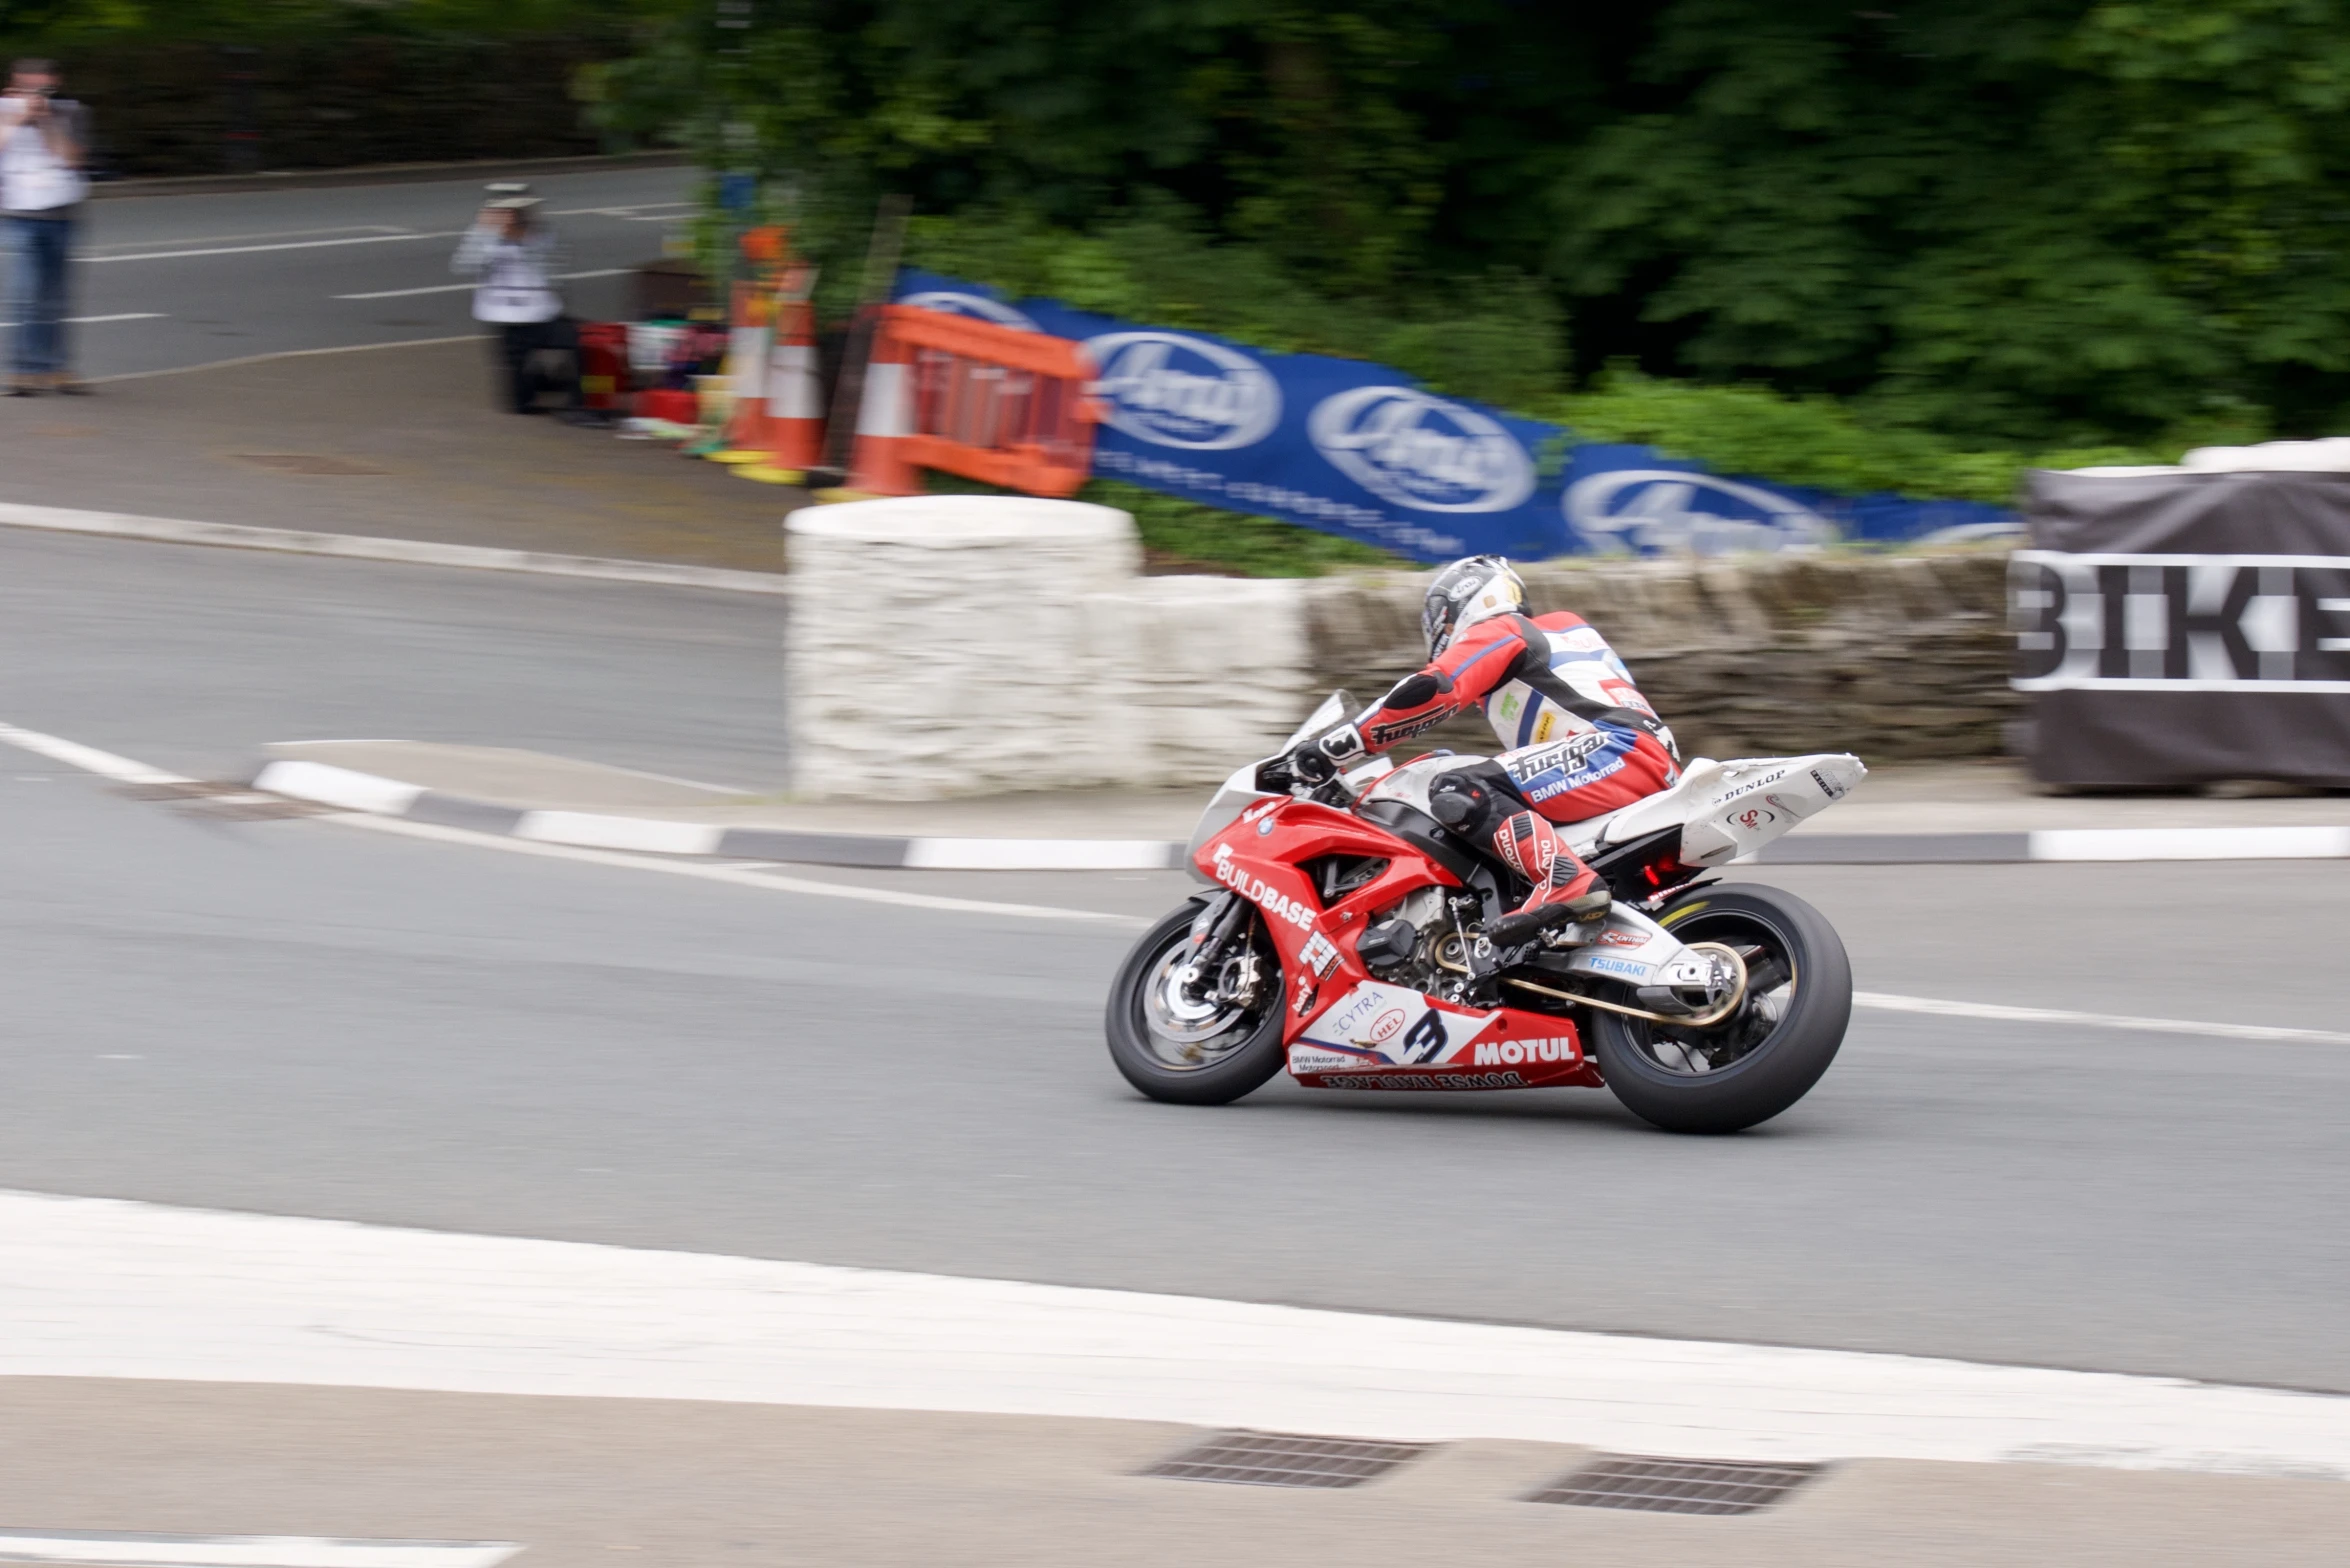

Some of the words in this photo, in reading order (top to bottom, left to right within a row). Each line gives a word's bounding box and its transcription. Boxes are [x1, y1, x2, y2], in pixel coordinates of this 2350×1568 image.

[1531, 778, 1567, 803] BMW
[1568, 756, 1627, 788] Motorrad
[1725, 769, 1785, 801] DUNLOP
[1216, 858, 1318, 932] BUILDBASE
[1590, 957, 1647, 977] TSUBAKI
[1377, 1017, 1401, 1038] HEL
[1403, 1008, 1449, 1064] 3
[1292, 1056, 1310, 1064] BMW
[1312, 1055, 1346, 1064] Motorrad
[1474, 1037, 1576, 1066] MOTUL
[1322, 1074, 1436, 1089] HAULAGE
[1438, 1070, 1524, 1089] DOWSE
